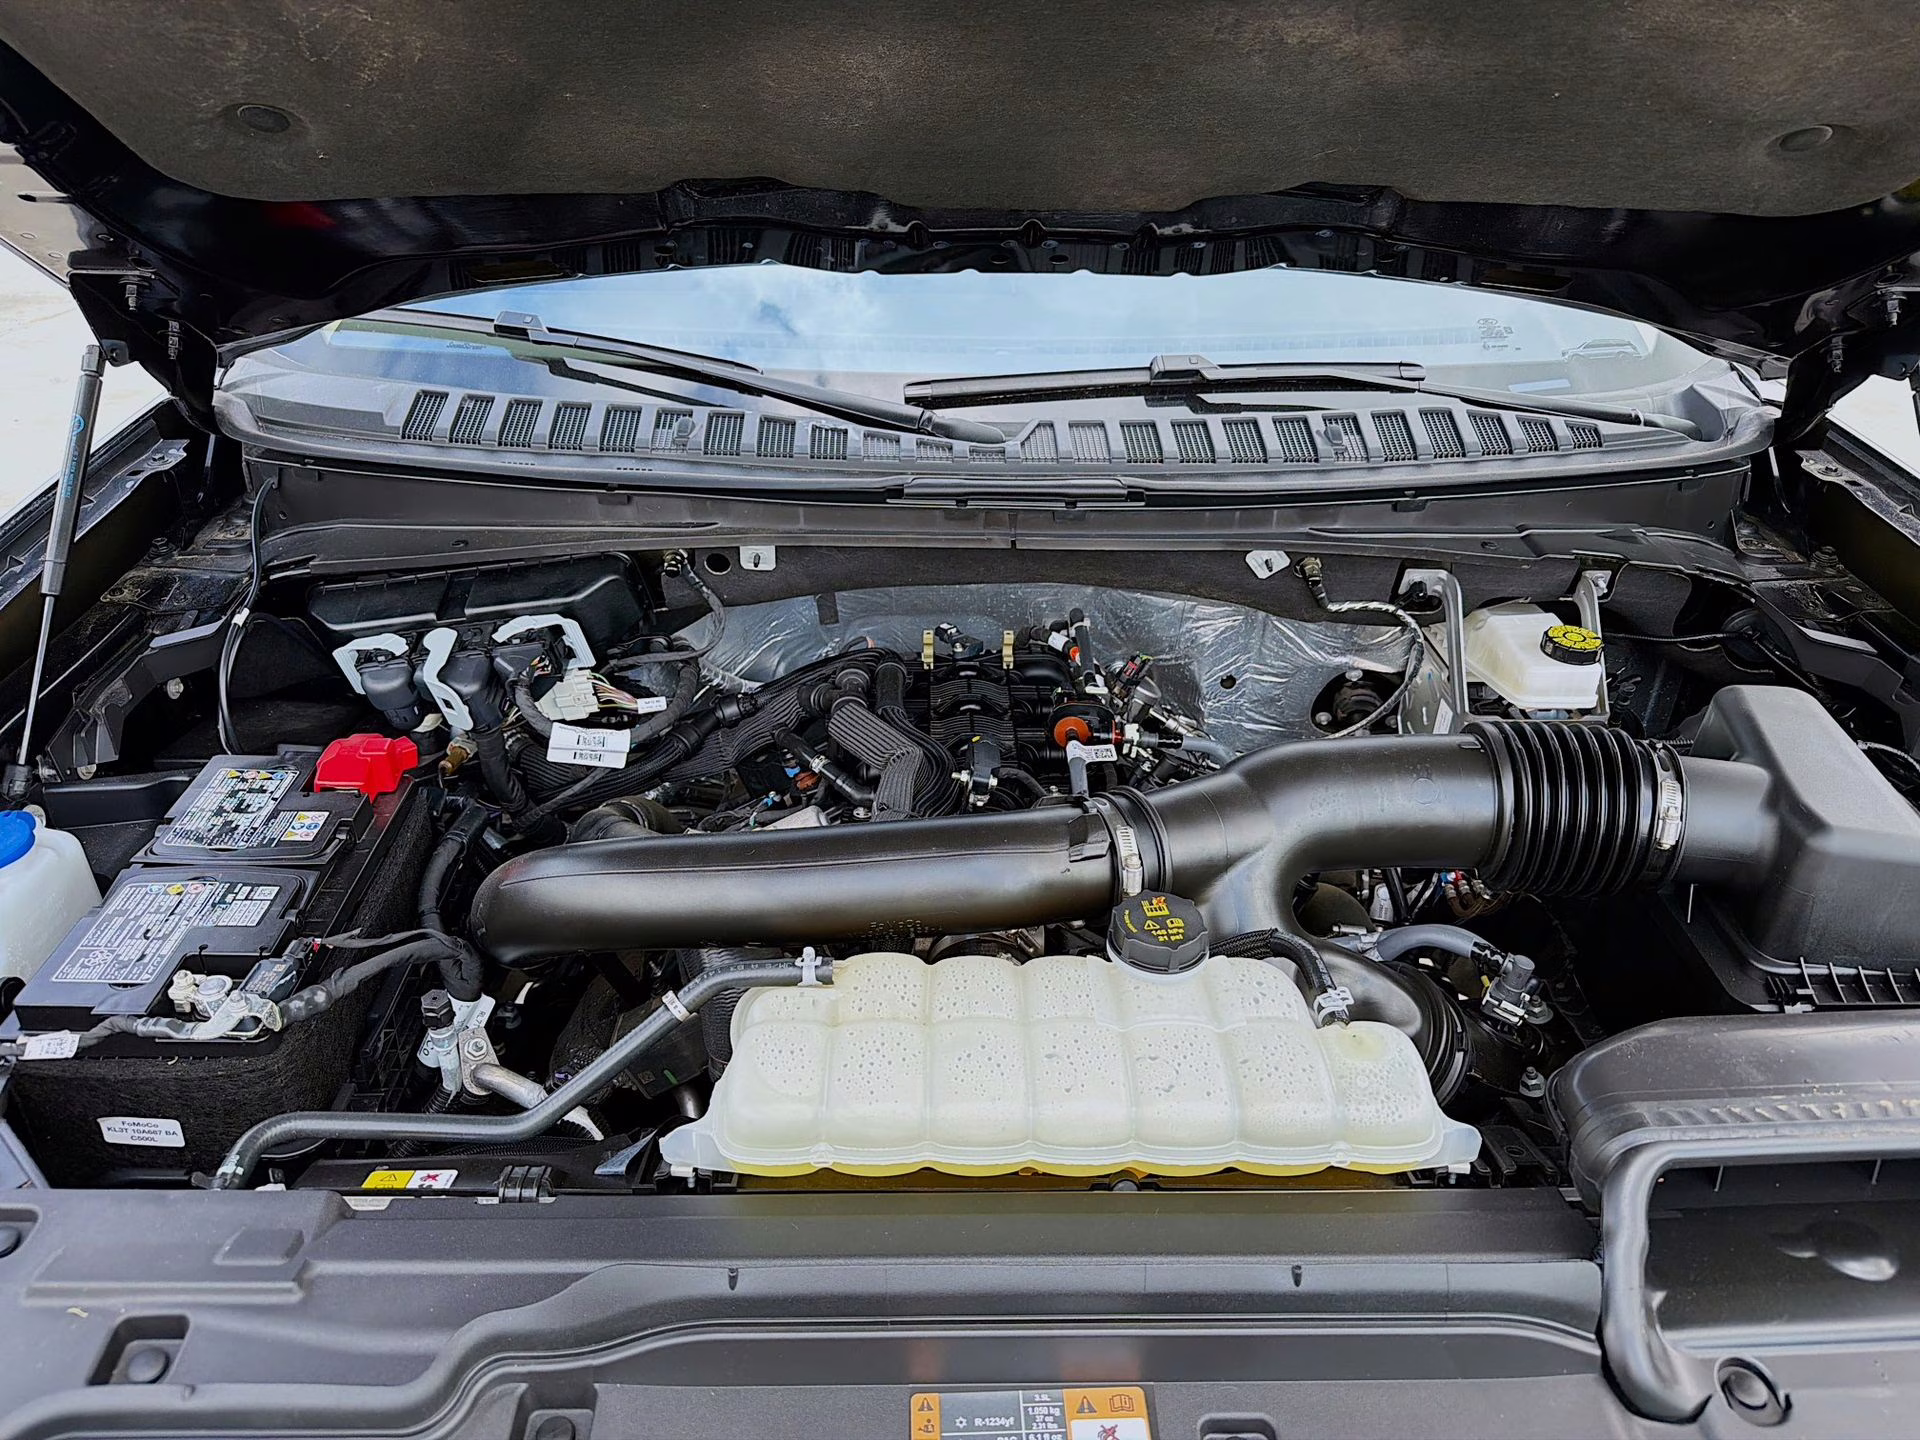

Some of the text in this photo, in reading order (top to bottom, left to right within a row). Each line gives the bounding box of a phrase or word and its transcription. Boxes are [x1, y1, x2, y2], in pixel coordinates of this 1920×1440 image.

[121, 1120, 159, 1128] FoMoCo
[106, 1126, 128, 1134] KL3T
[1027, 1406, 1061, 1417] 1.050 kg
[974, 1416, 1015, 1428] R-1234yf
